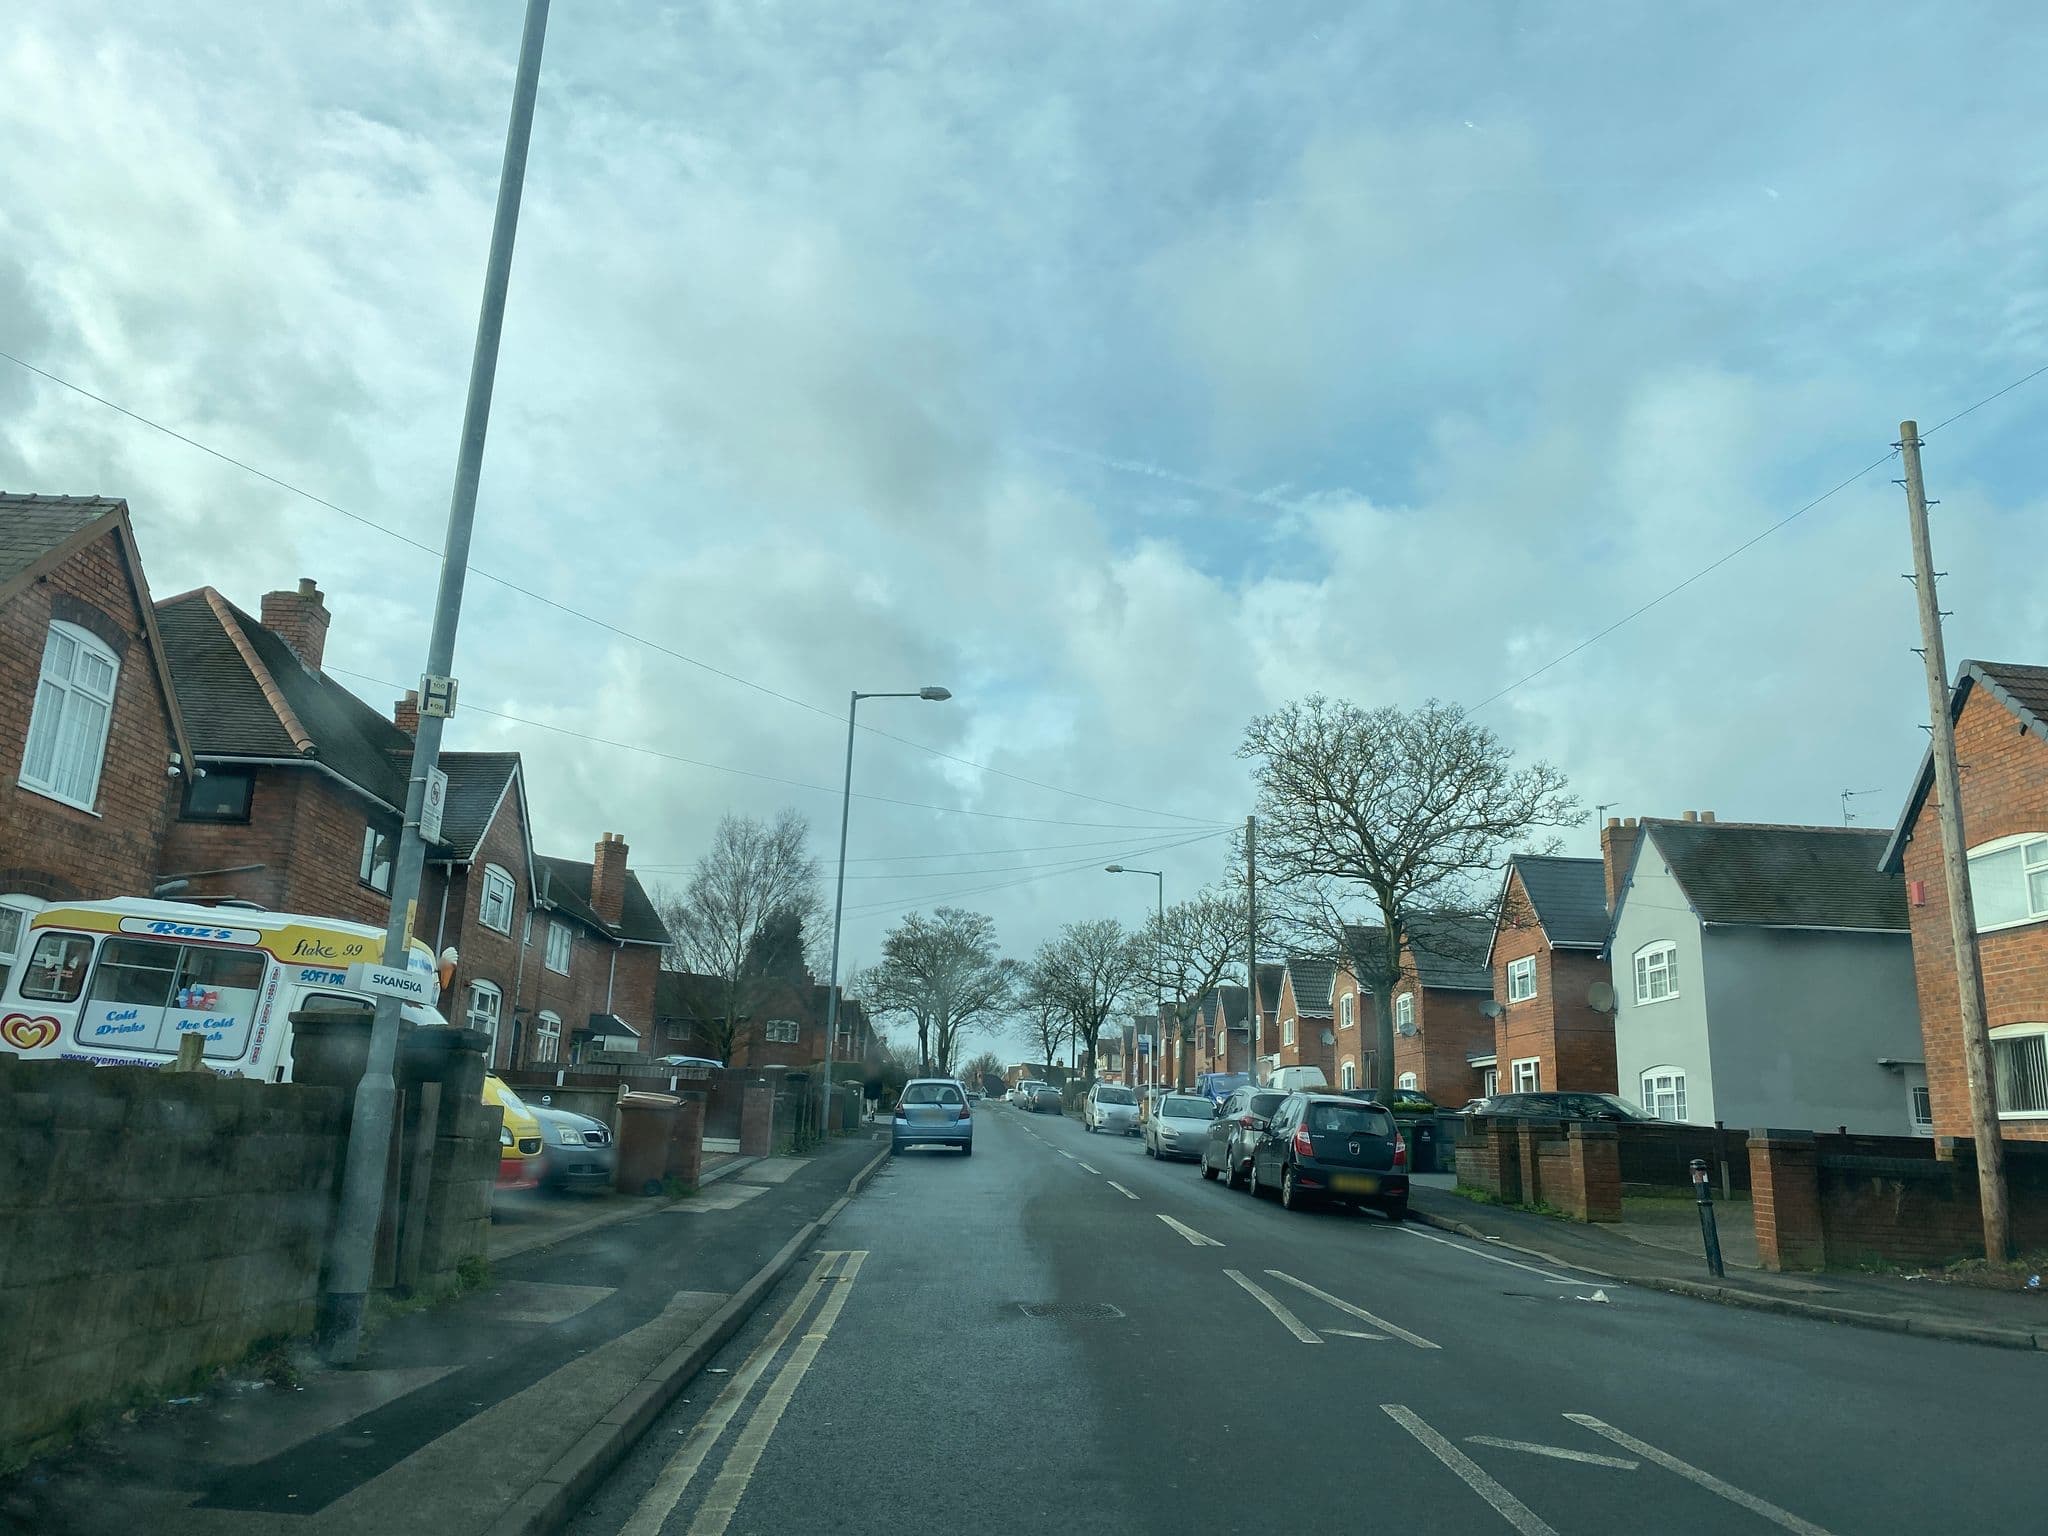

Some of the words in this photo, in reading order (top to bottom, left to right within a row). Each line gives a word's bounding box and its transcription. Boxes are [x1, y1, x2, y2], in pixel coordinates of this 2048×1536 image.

[147, 922, 232, 939] Raz's
[301, 969, 329, 983] SOFT
[372, 974, 422, 993] SKANSKA
[106, 1010, 137, 1021] Cold
[95, 1023, 145, 1035] Drinks
[176, 1019, 200, 1031] Ice
[203, 1018, 234, 1028] Cold
